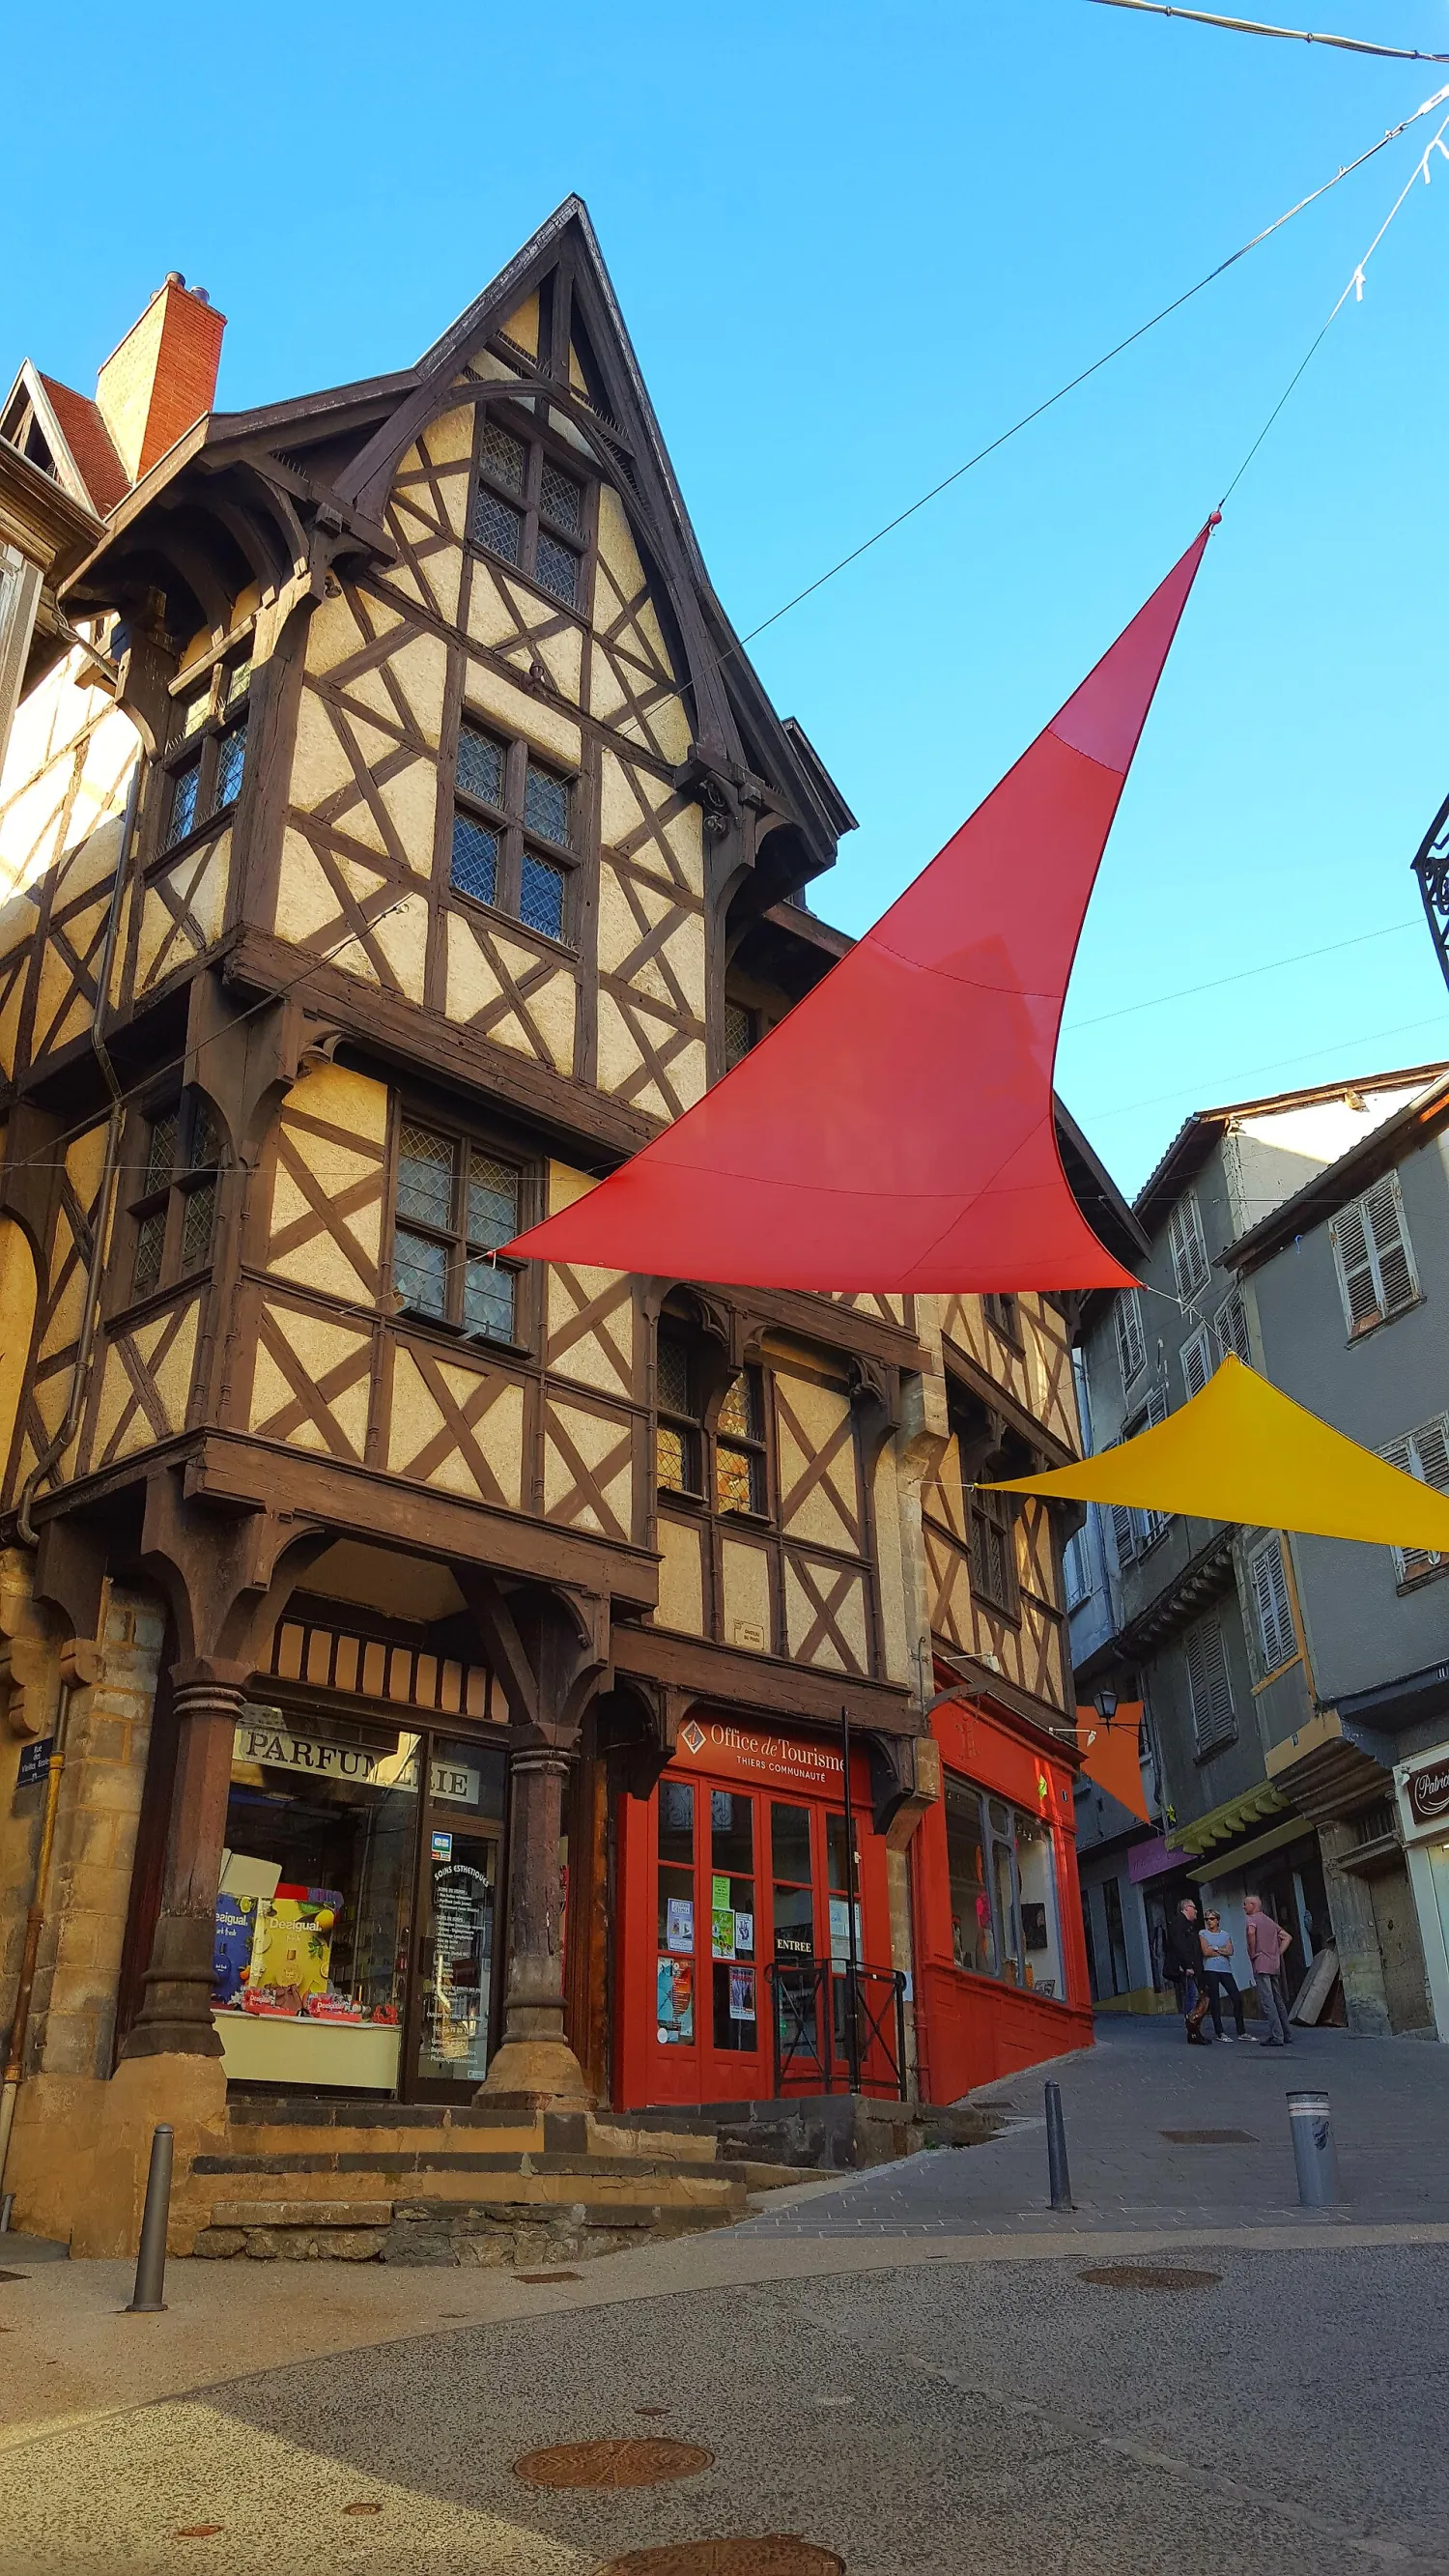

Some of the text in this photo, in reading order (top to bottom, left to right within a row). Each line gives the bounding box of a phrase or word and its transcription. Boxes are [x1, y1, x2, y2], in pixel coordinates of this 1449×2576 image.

[34, 1745, 43, 1754] Rue
[710, 1723, 845, 1773] Office de Tourisme
[38, 1758, 49, 1767] Ecole
[736, 1755, 826, 1783] THIERS COMMUNAUTÉ
[1418, 1771, 1449, 1799] Patric
[434, 1864, 489, 1888] SOINS ESTHETIQUES
[777, 1938, 811, 1953] ENTREE
